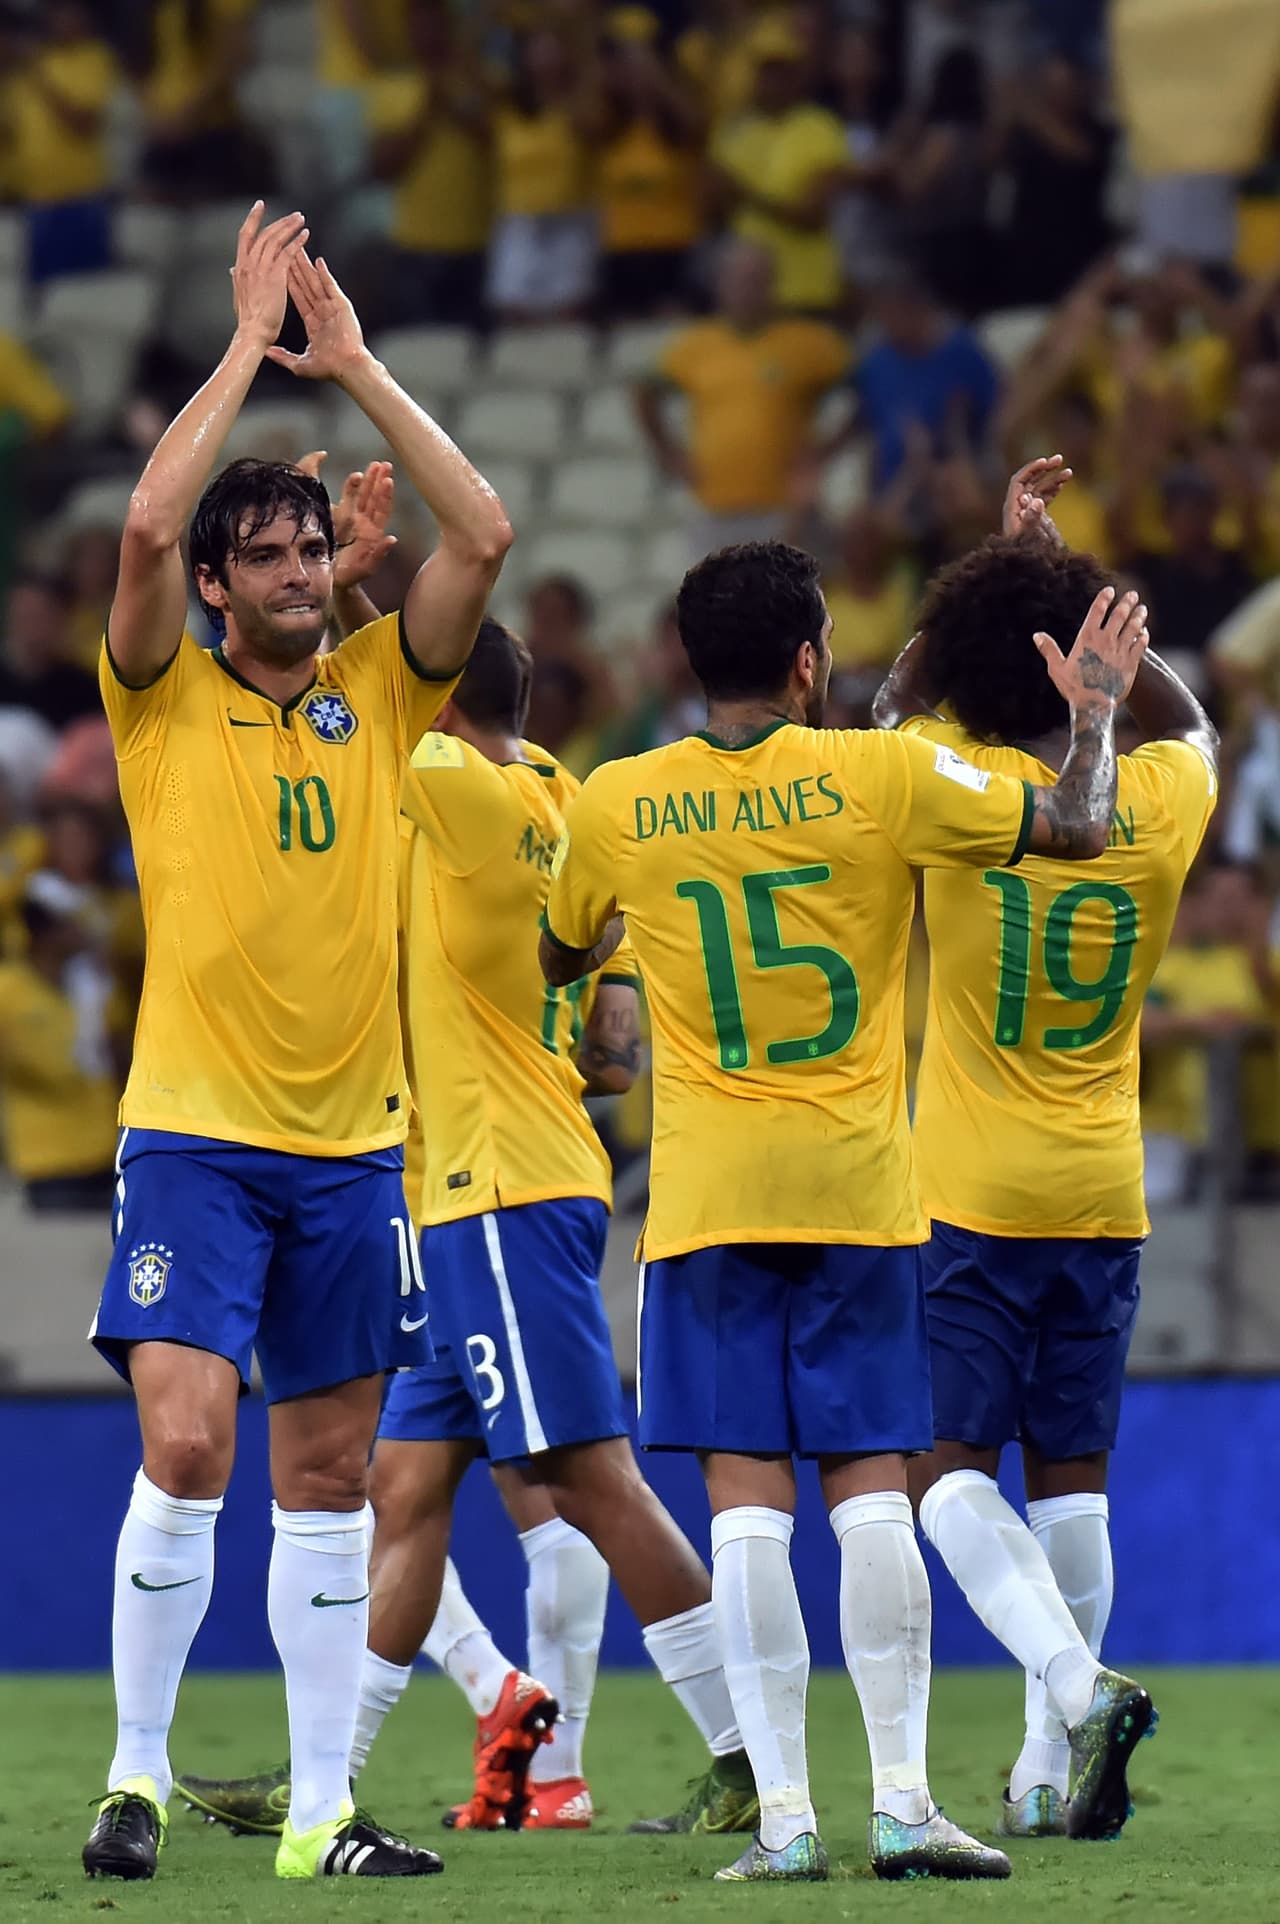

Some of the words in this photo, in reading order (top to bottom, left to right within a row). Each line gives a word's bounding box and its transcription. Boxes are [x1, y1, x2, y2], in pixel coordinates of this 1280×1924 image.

[273, 774, 336, 853] 10
[634, 790, 717, 840] DANI
[731, 772, 844, 833] ALVES
[675, 863, 860, 1072] 15
[982, 868, 1138, 1050] 19
